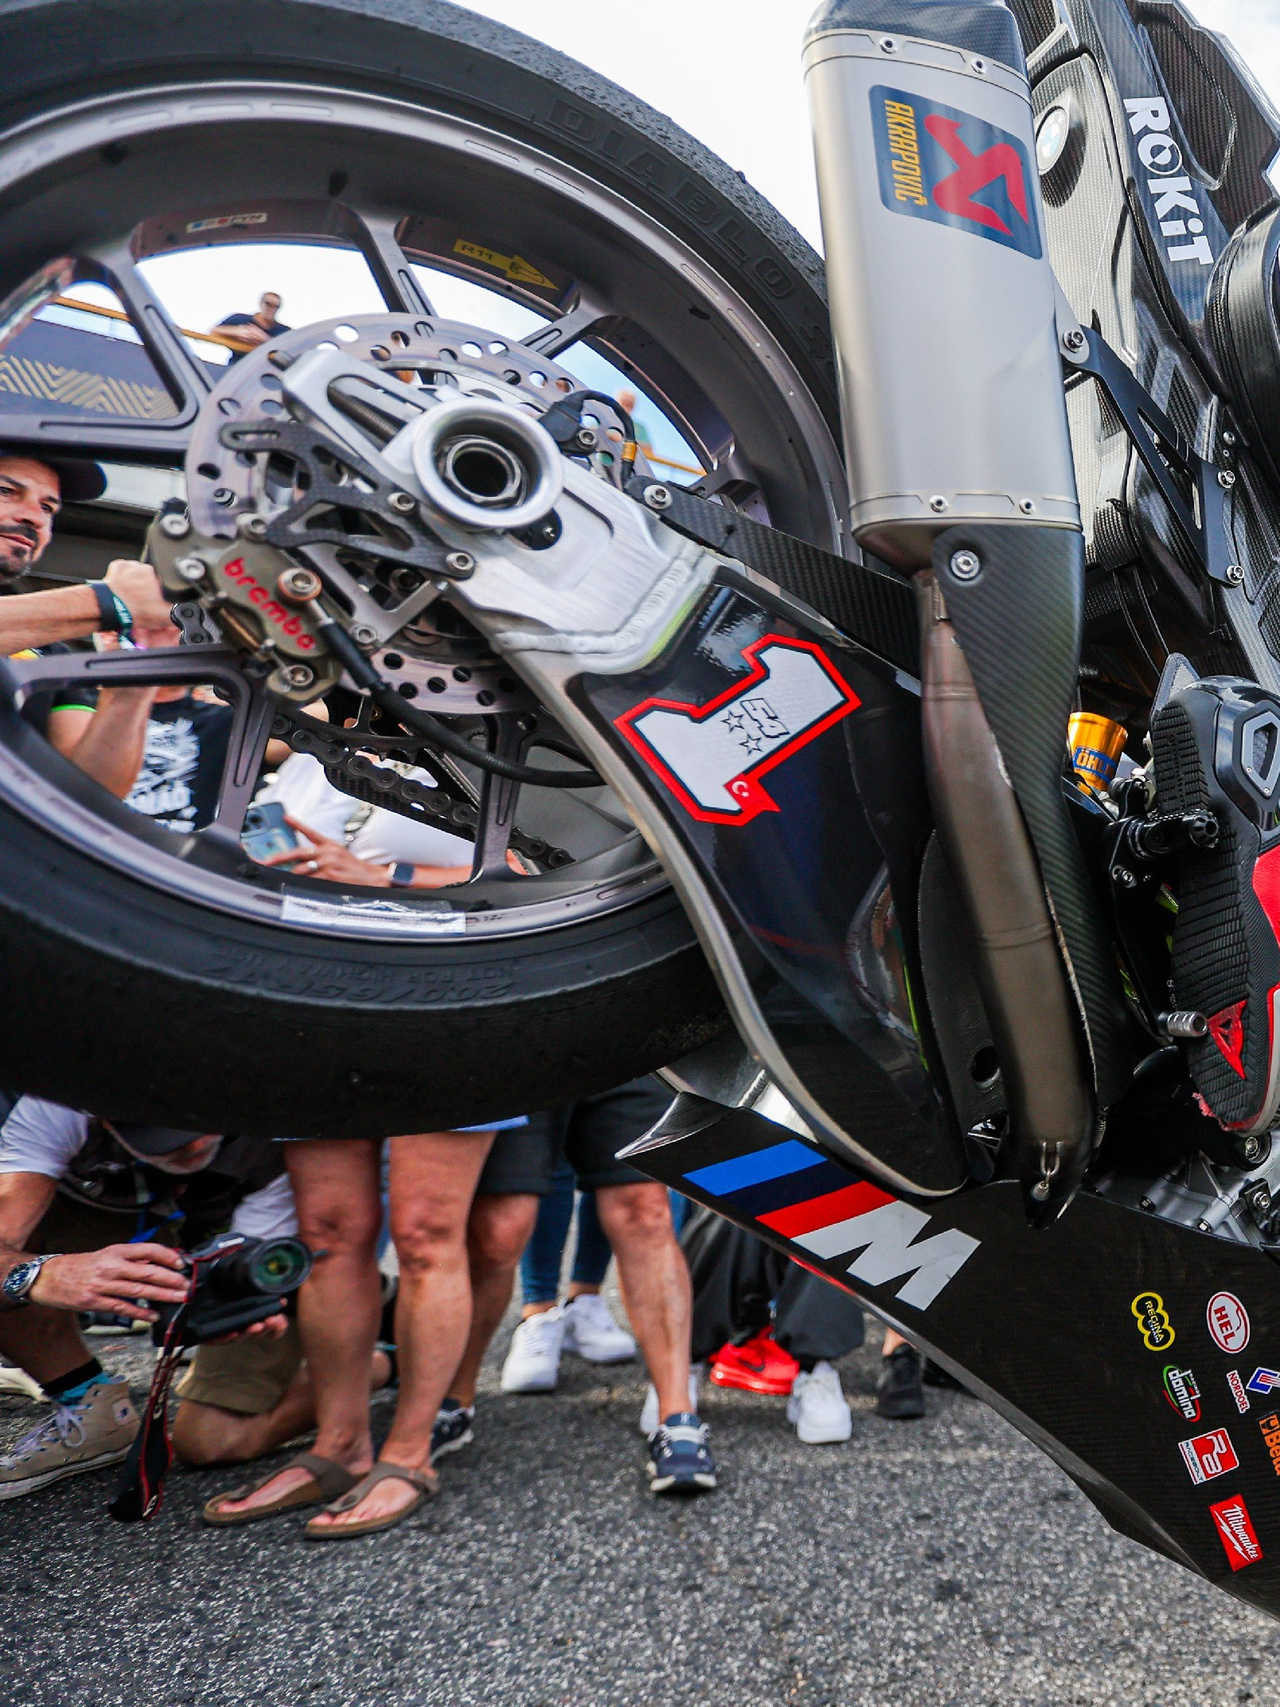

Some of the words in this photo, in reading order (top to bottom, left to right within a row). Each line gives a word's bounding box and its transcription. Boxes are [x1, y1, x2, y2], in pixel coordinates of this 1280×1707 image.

[223, 556, 316, 650] brembo
[790, 1200, 982, 1311] M
[1144, 1300, 1165, 1343] REGINA
[1213, 1305, 1236, 1346] HEL
[1227, 1372, 1249, 1413] NORDOEL
[1221, 1503, 1259, 1560] Milwaukee
